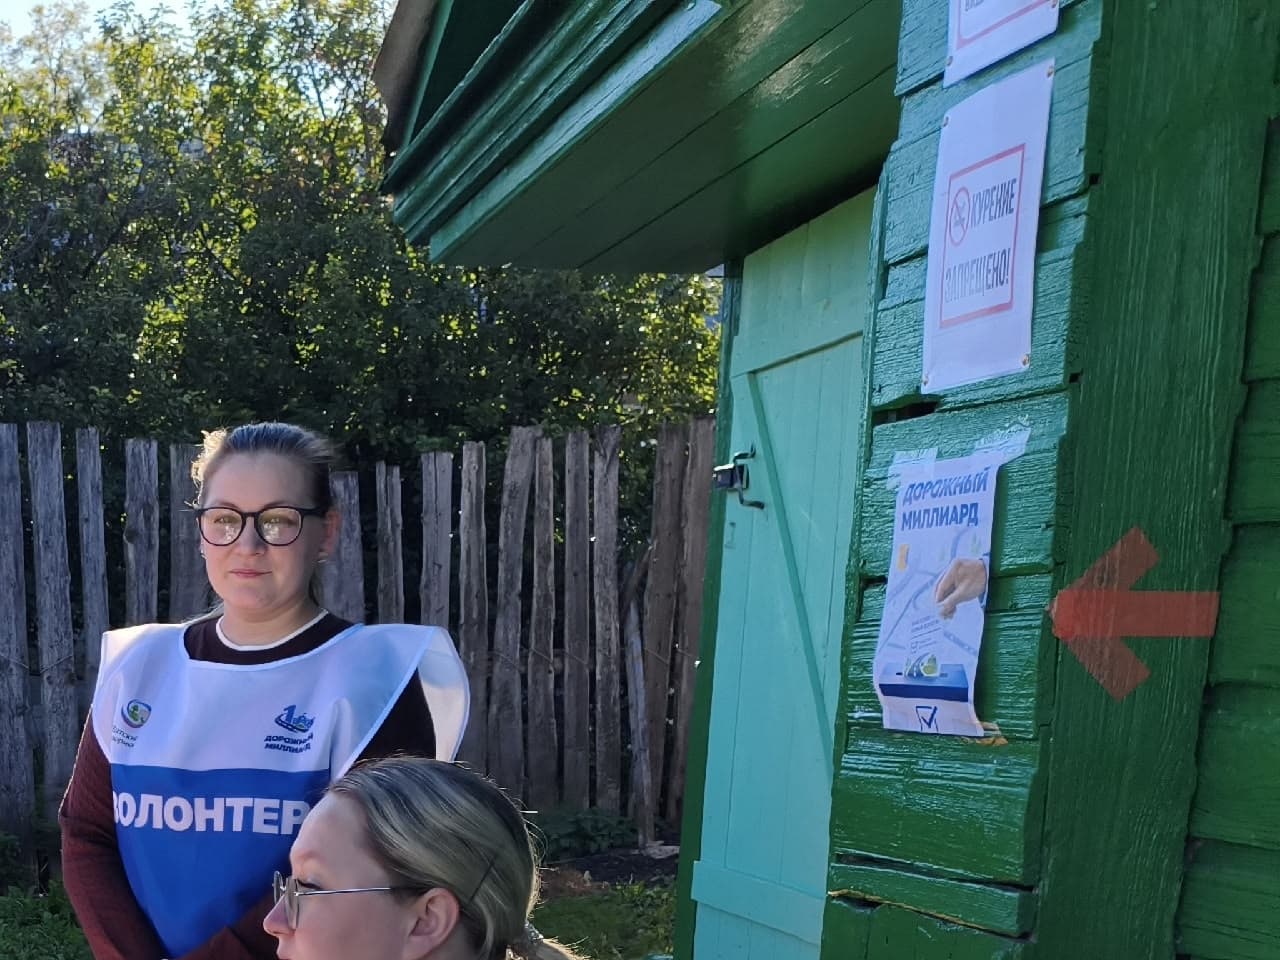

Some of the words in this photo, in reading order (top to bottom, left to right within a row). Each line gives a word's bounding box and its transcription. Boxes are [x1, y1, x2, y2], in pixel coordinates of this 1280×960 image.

[970, 178, 1017, 228] КУРЕНИЕ
[944, 248, 1011, 303] ЗАПРЕЩЕНО!
[902, 466, 991, 507] ДОРОЖНЫЙ
[901, 502, 979, 532] МИЛЛИАРД
